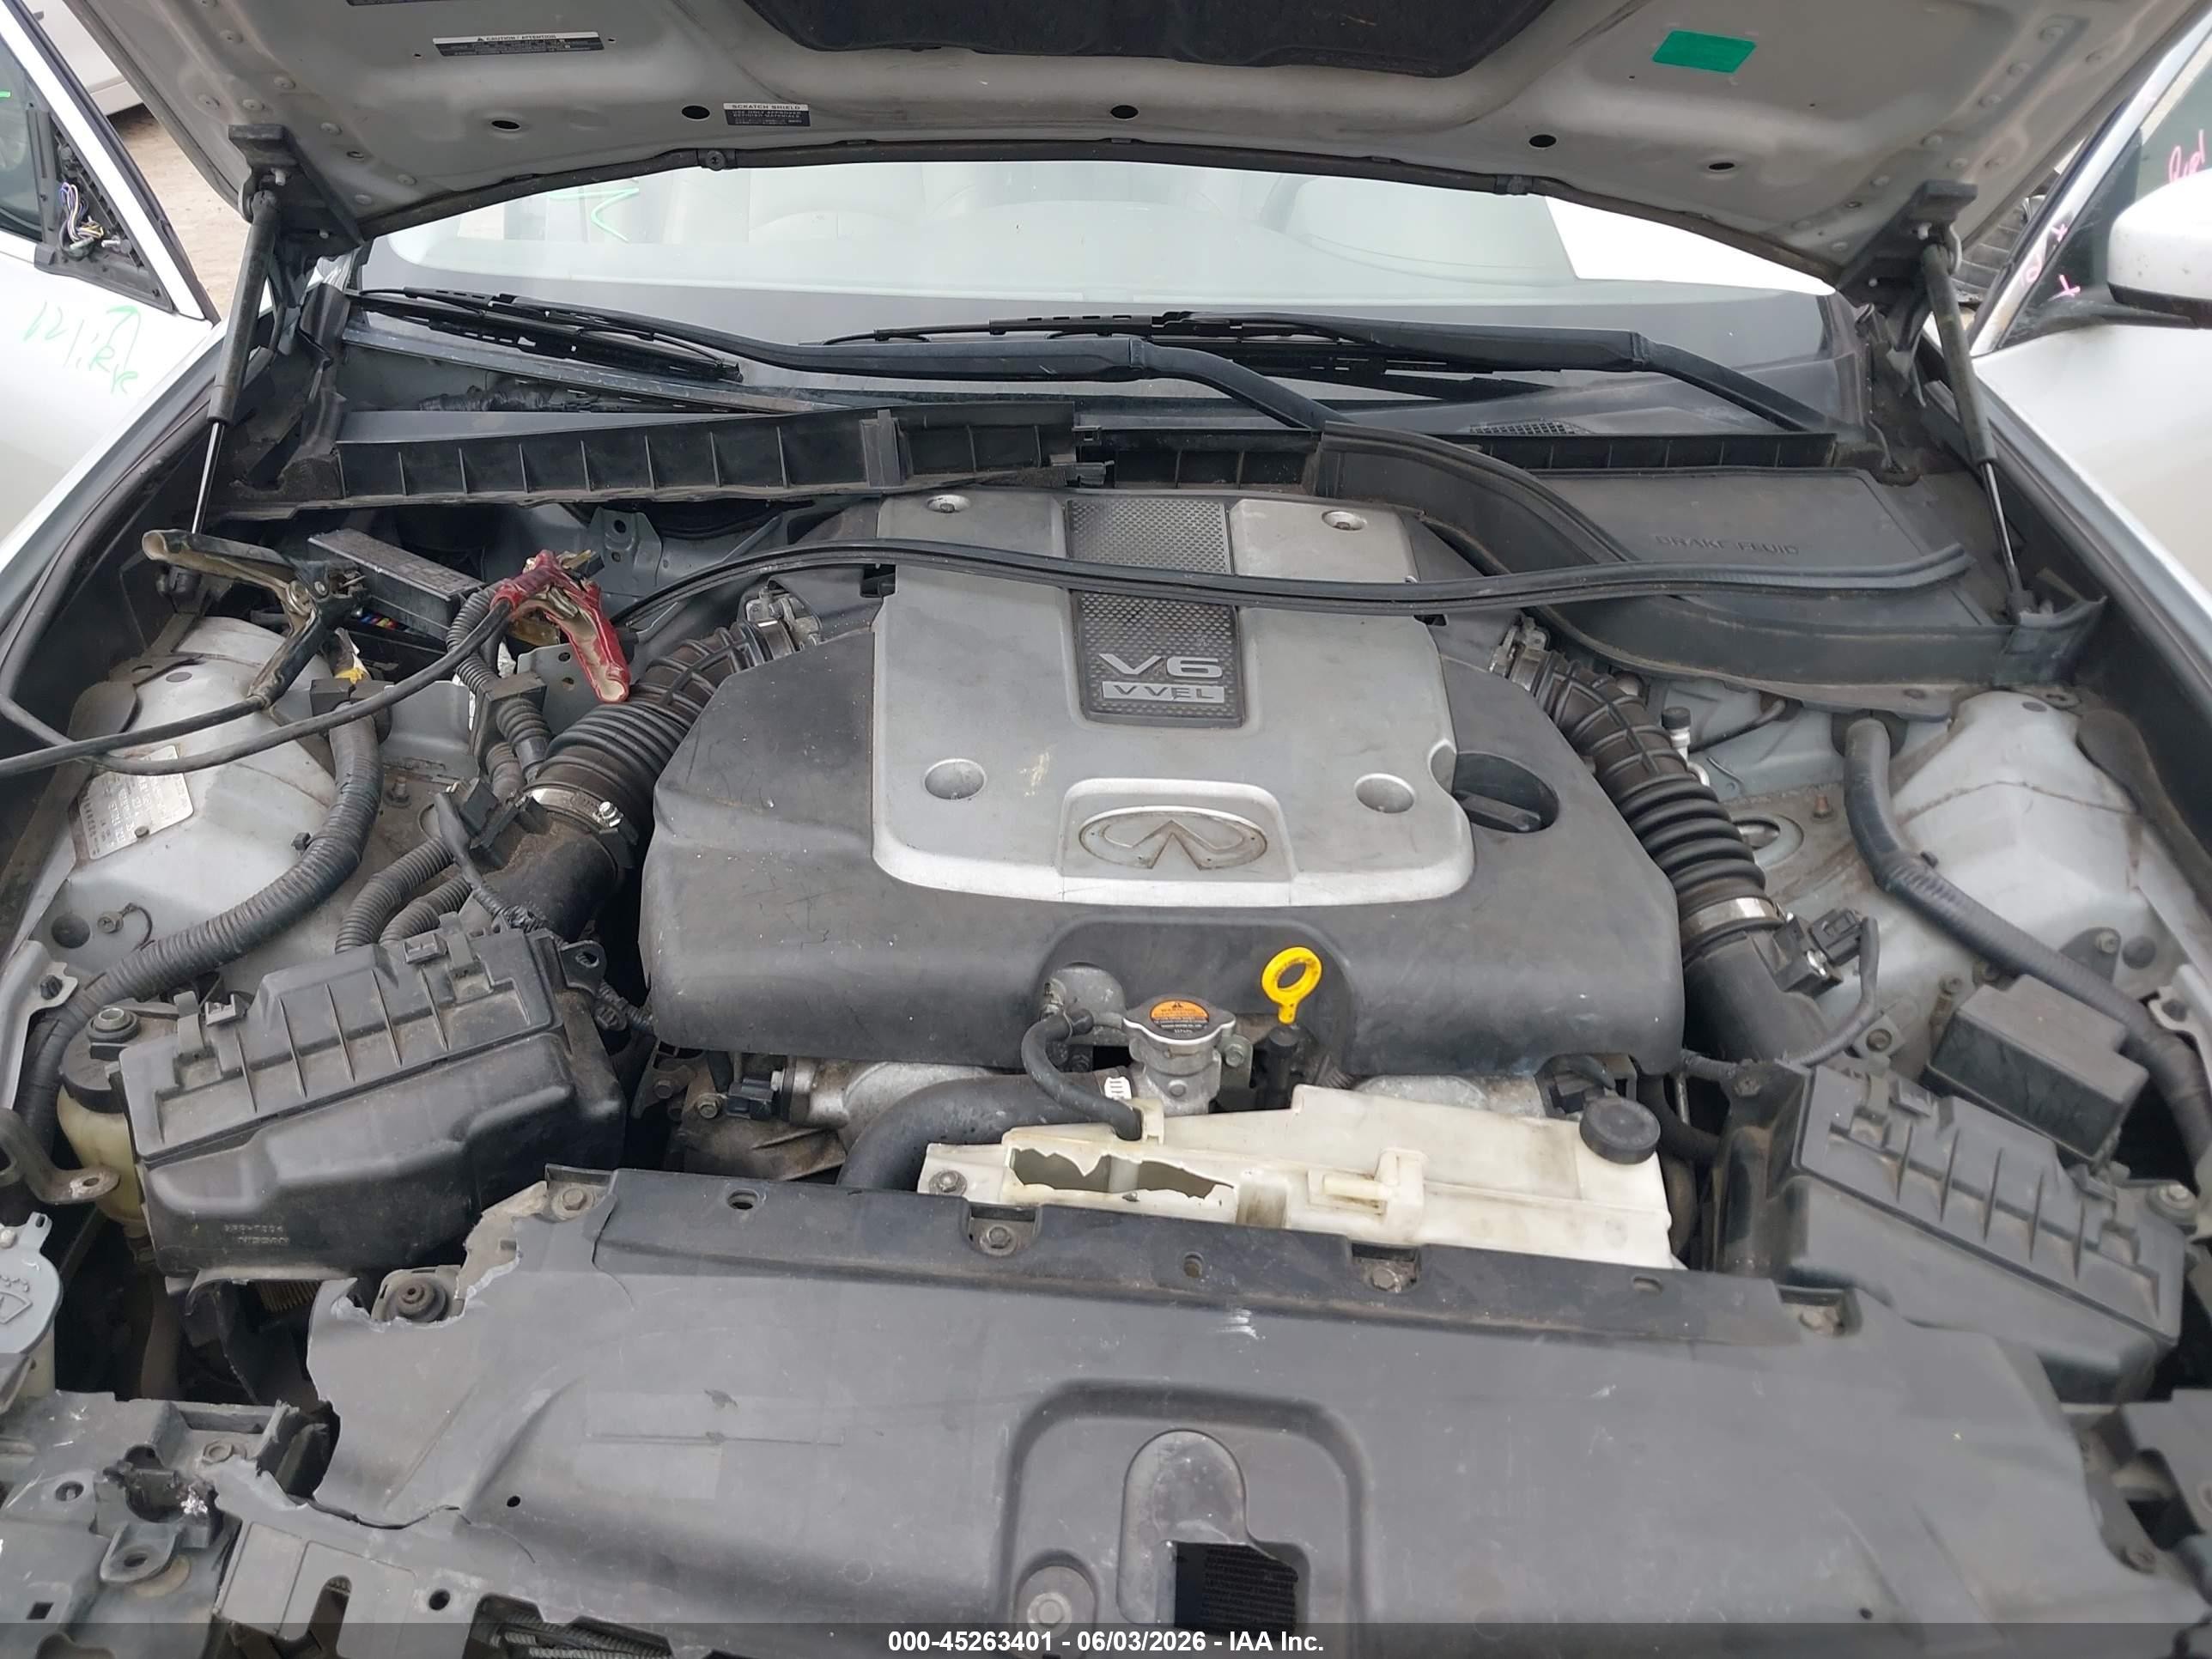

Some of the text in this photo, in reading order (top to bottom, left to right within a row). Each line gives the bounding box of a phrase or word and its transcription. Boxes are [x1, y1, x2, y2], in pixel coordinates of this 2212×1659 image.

[1737, 541, 1800, 555] FLUID
[1098, 653, 1224, 678] V6
[1113, 684, 1216, 700] VVEL
